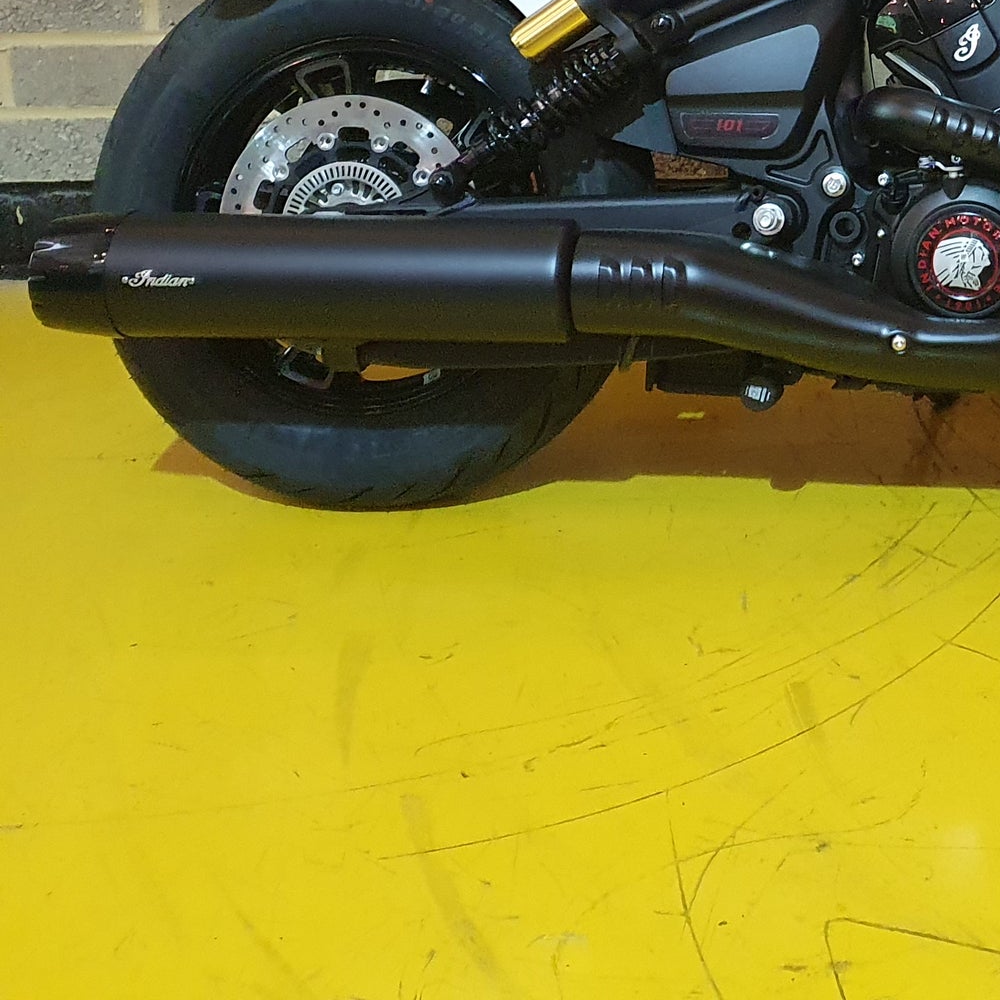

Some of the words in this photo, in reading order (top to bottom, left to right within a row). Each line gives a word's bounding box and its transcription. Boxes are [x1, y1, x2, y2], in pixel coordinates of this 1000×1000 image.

[716, 119, 744, 132] 101
[917, 228, 943, 292] INDIAN
[128, 269, 188, 288] Indian
